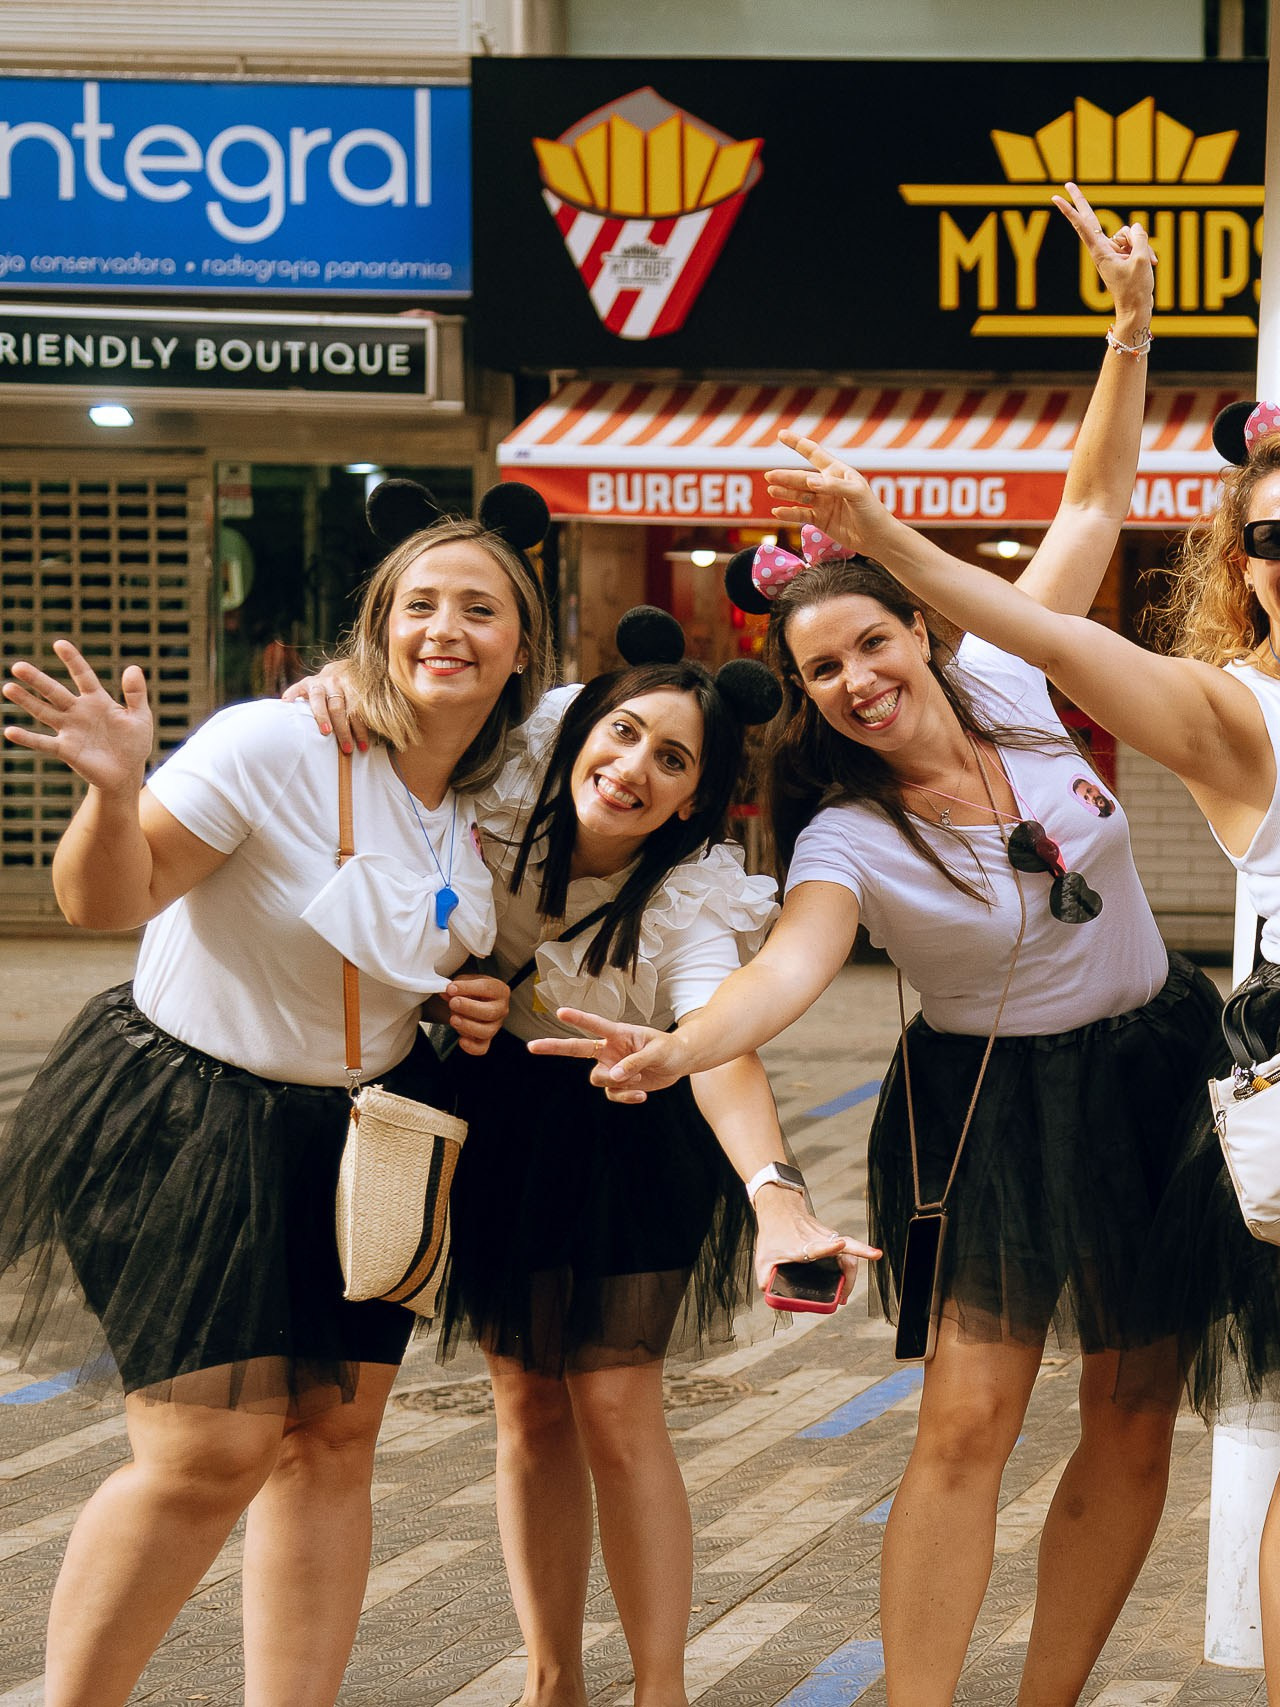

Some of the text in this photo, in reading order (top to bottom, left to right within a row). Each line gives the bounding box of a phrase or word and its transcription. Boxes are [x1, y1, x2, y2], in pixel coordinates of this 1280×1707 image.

[0, 82, 431, 244] ntegral
[30, 251, 176, 275] conservadora
[939, 210, 1051, 311] MY
[0, 332, 412, 376] RIENDLY BOUTIQUE
[588, 472, 753, 514] BURGER
[870, 476, 1007, 516] OTDOG
[1131, 477, 1225, 517] NACK
